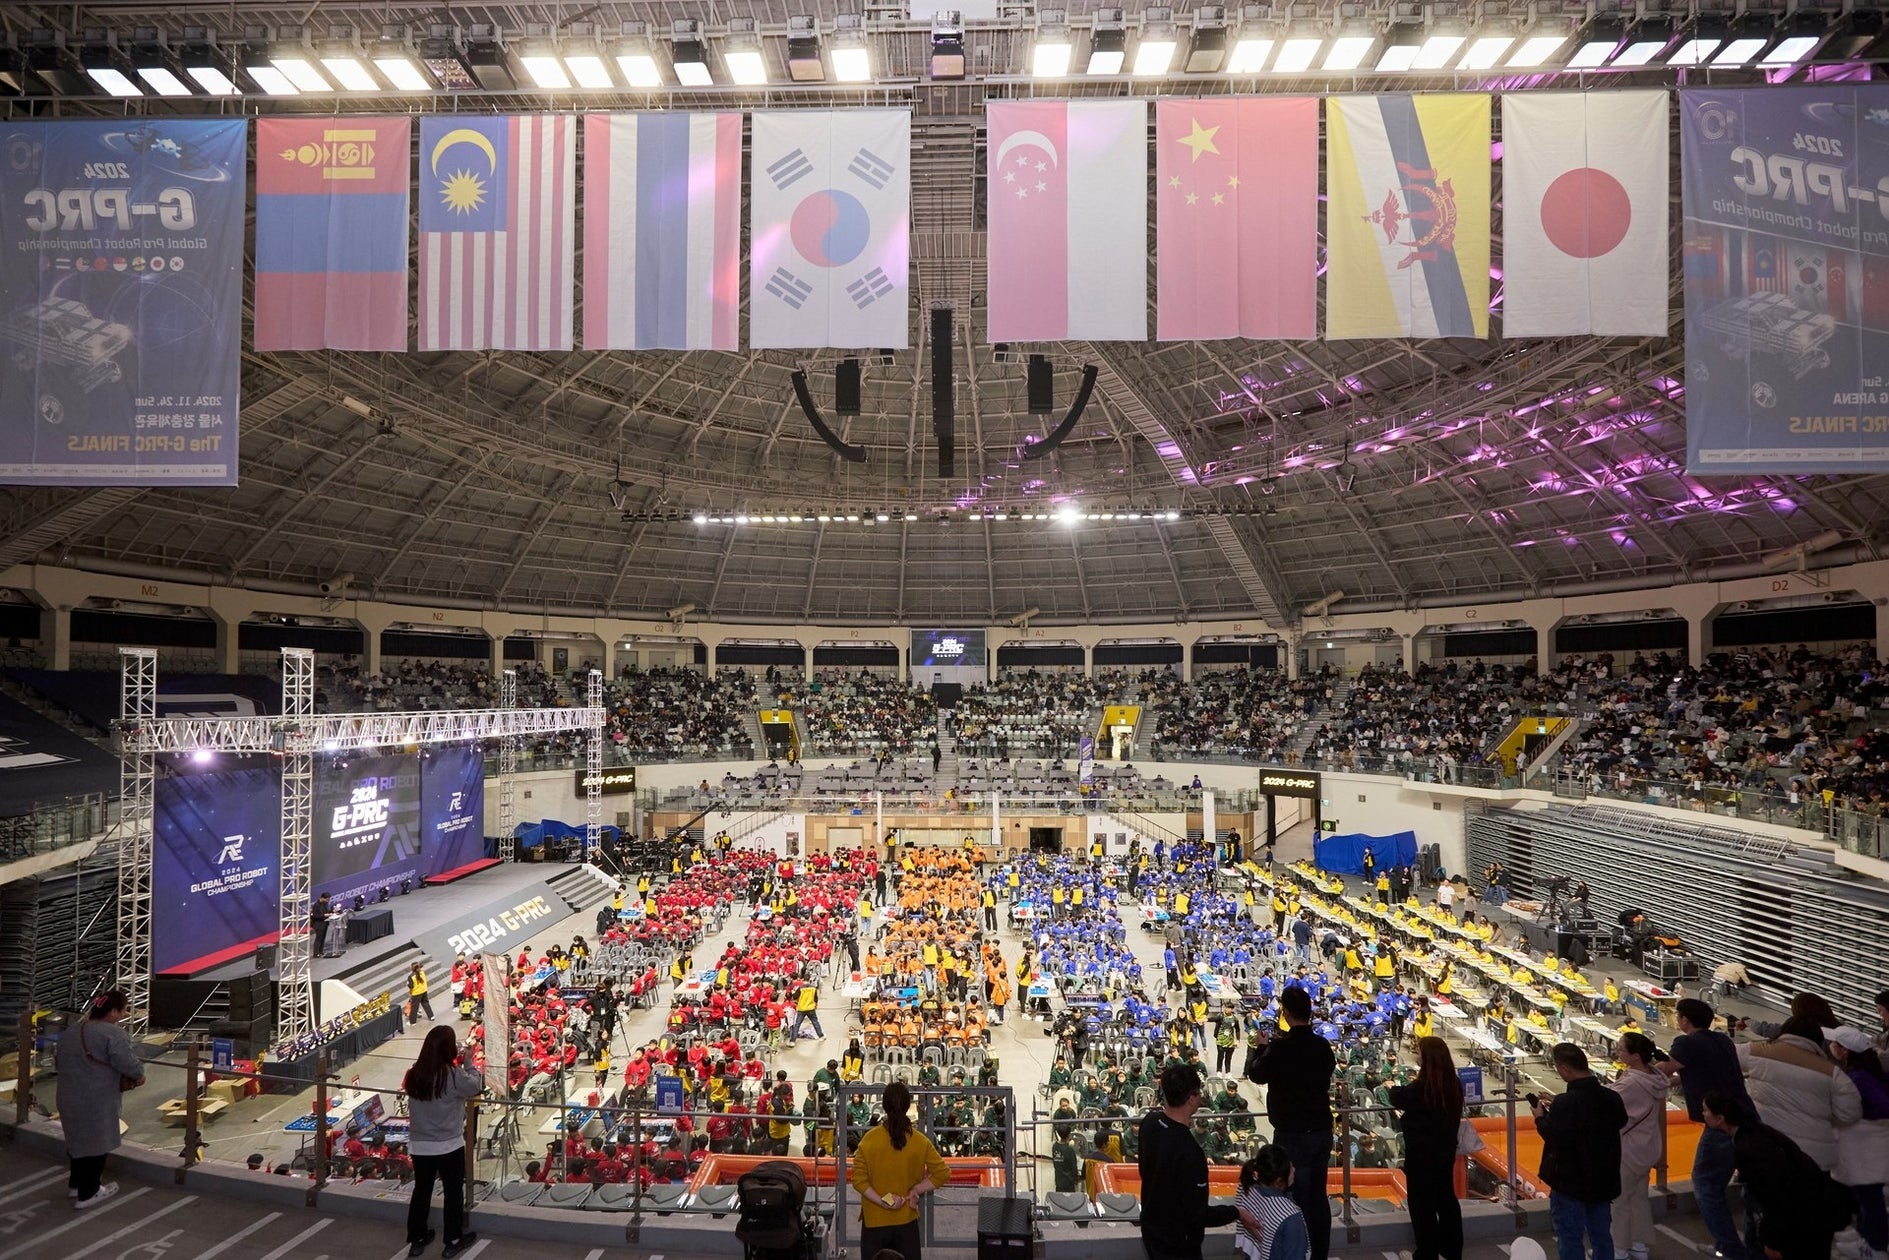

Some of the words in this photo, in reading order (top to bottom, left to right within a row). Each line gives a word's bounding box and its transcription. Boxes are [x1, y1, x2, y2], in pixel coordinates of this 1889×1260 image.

[141, 584, 159, 597] M2
[1772, 579, 1789, 592] D2
[432, 612, 444, 622] N2
[1465, 609, 1477, 619] C2
[605, 774, 634, 785] G-PRC
[1263, 777, 1286, 786] 2024
[1286, 779, 1315, 789] G-PRC
[350, 785, 378, 804] 2024
[332, 798, 390, 831] G-PRC
[221, 866, 241, 876] 2024
[191, 878, 223, 893] GLOBAL
[224, 873, 241, 885] PRO
[242, 866, 268, 880] ROBOT
[344, 884, 369, 900] ROBOT
[368, 869, 416, 892] CHAMPIONSHIP
[207, 879, 254, 896] CHAMPIONSHIP
[447, 917, 507, 957] 2024
[498, 895, 552, 931] G-PRC
